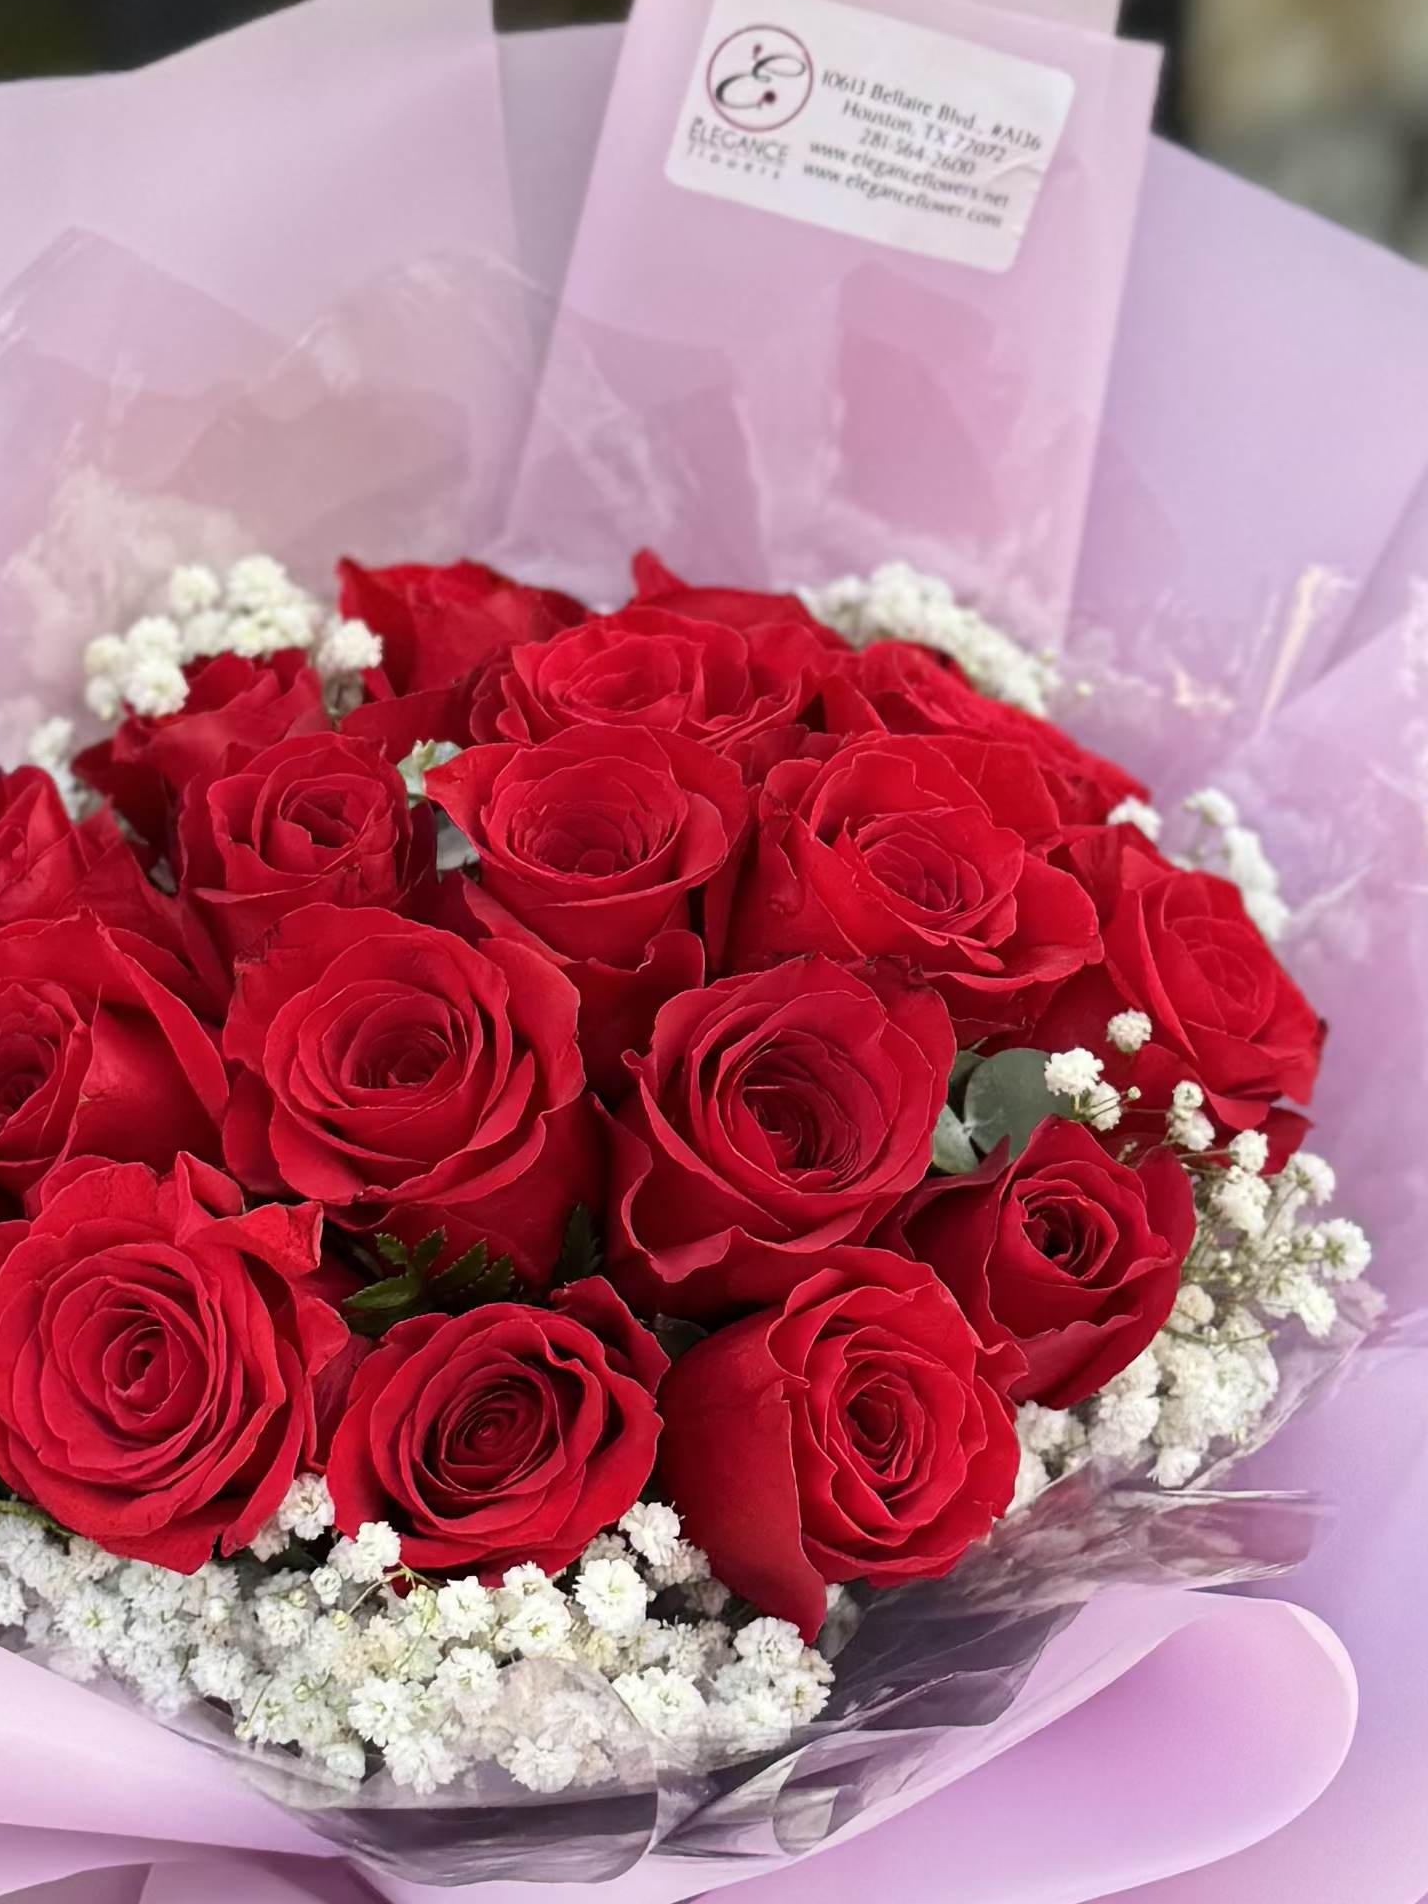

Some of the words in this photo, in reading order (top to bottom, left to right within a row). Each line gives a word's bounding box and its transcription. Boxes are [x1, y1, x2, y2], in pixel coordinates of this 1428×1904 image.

[821, 69, 867, 96] 10613
[870, 83, 932, 117] Bellaire
[991, 122, 1042, 152] #A136
[688, 117, 788, 166] ELEGANCE
[859, 127, 976, 176] 281-564-2600
[925, 122, 948, 146] TX
[952, 134, 1006, 163] 77072
[802, 162, 1003, 228] www.eleganceflower.com
[808, 140, 1010, 208] www.eleganceflowers.net
